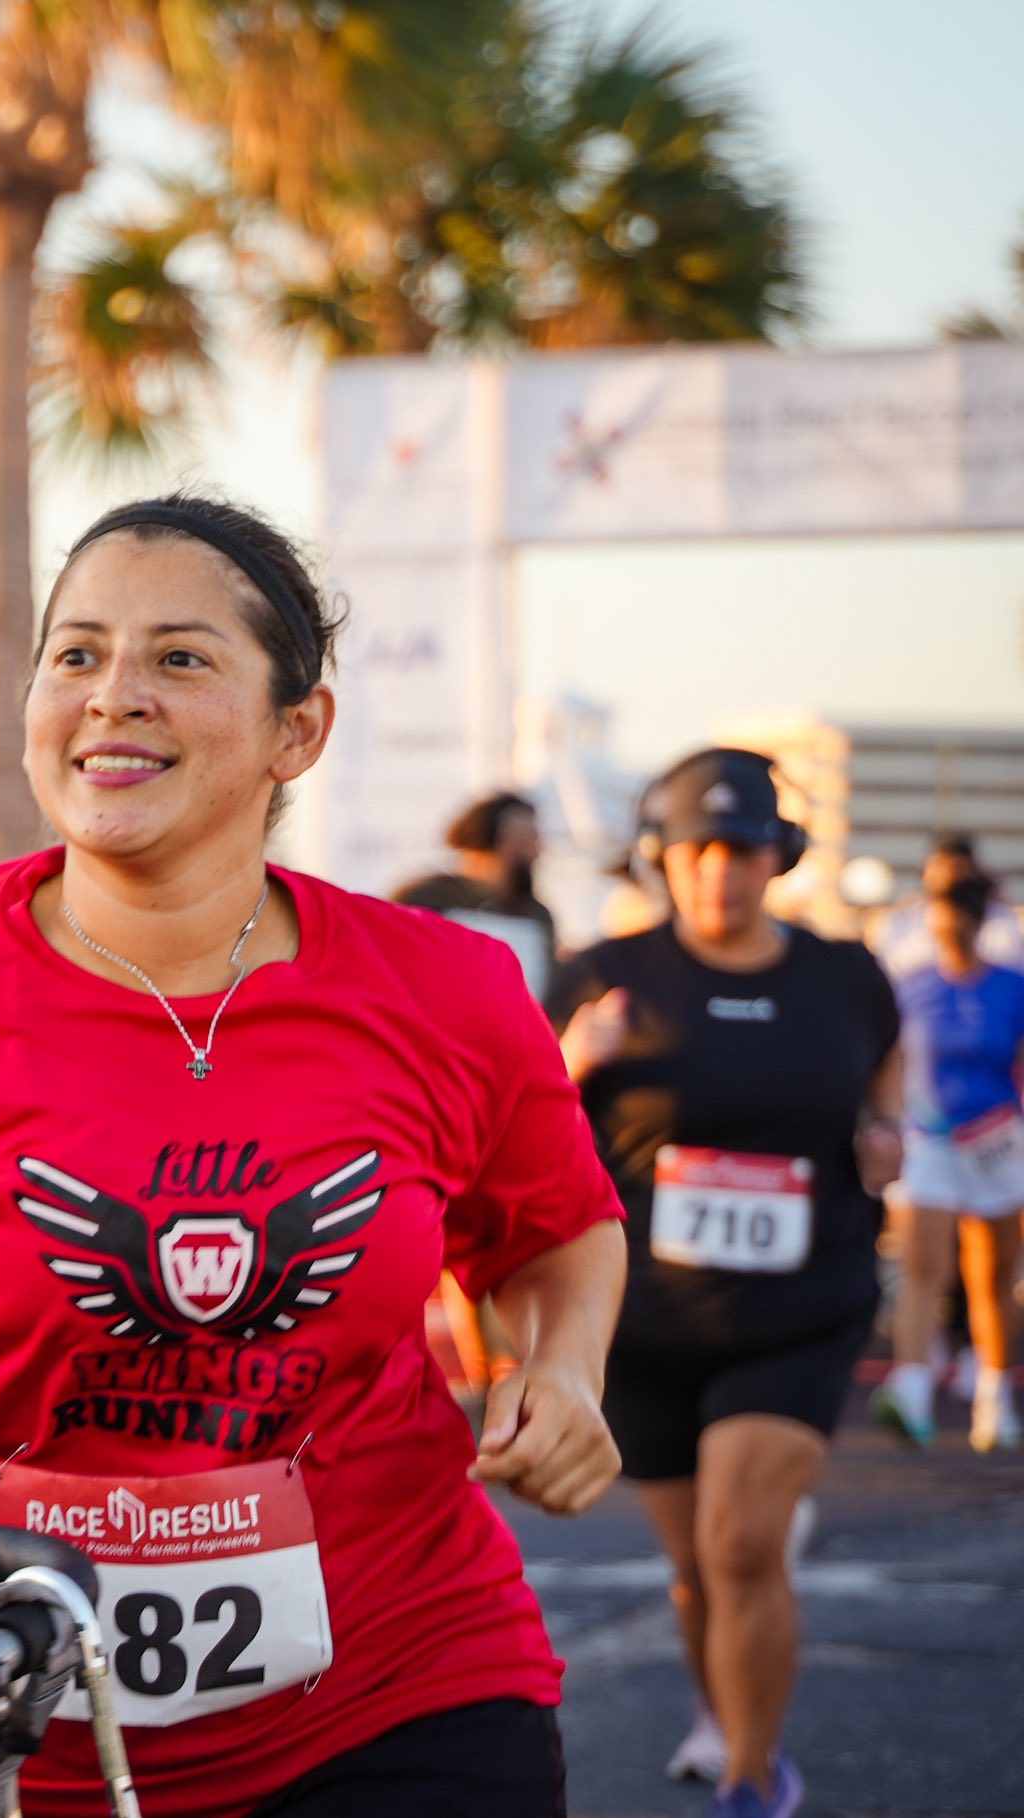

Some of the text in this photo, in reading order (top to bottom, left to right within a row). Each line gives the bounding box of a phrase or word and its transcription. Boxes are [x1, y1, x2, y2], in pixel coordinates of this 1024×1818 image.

[138, 1139, 284, 1199] Little
[684, 1202, 776, 1249] 710
[173, 1246, 241, 1297] W
[73, 1343, 325, 1405] WINGS
[26, 1493, 261, 1540] RACE RESULT
[86, 1541, 134, 1557] Passion
[142, 1542, 190, 1557] German
[192, 1532, 261, 1554] Engineering
[74, 1585, 265, 1696] 82
